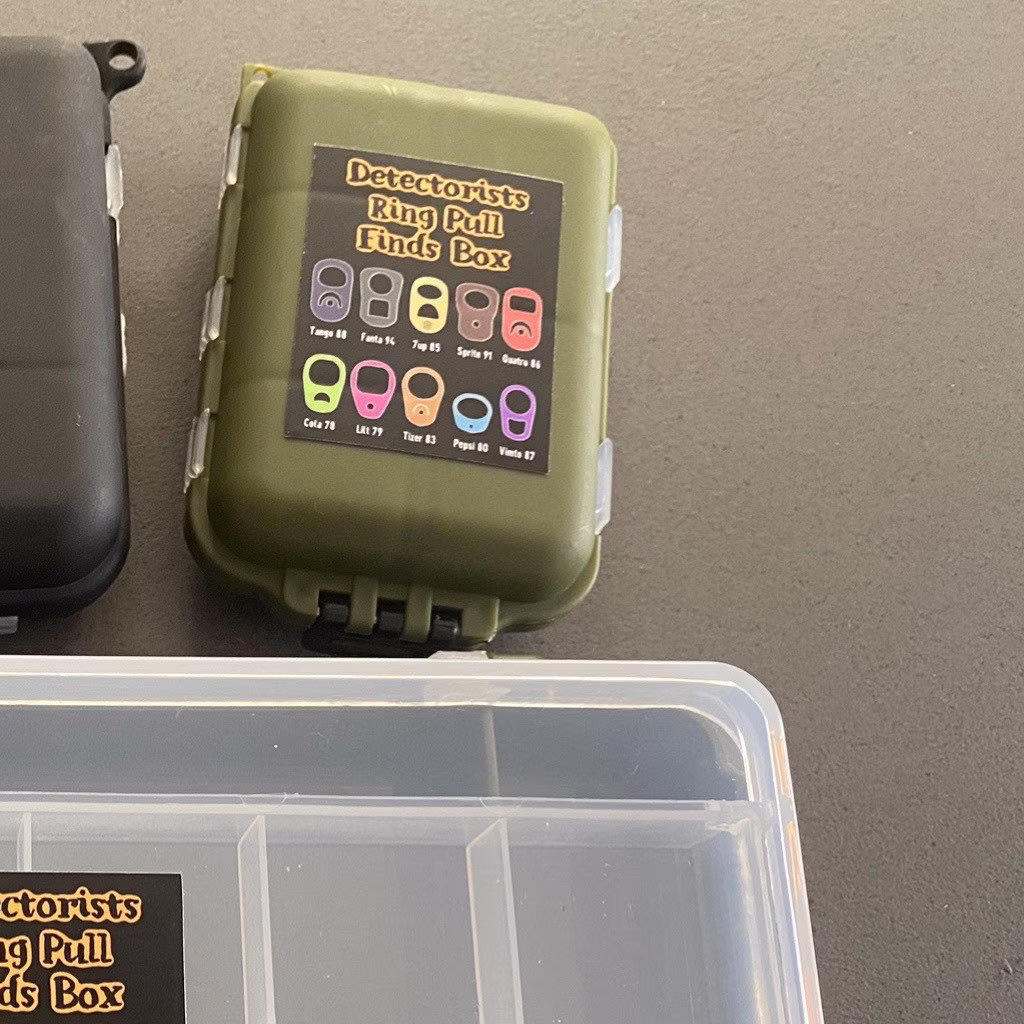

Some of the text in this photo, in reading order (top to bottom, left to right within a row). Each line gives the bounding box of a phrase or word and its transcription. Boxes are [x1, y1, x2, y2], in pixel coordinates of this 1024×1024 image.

[346, 157, 529, 211] Detectorists
[368, 194, 504, 238] Ring Pull
[356, 225, 511, 271] Finds Box
[310, 326, 347, 340] Tango 88
[361, 333, 395, 345] Fanta 94
[412, 340, 440, 352] 7up 85
[457, 346, 493, 361] Sprite 91
[502, 354, 541, 370] Quatro 86
[304, 418, 335, 431] Cola 78
[356, 425, 382, 436] Lilt 79
[403, 431, 436, 444] Tizer 83
[453, 438, 488, 453] Pepsi 80
[499, 446, 535, 461] Vimto 87
[39, 929, 114, 967] Pull
[50, 973, 125, 1013] Box
